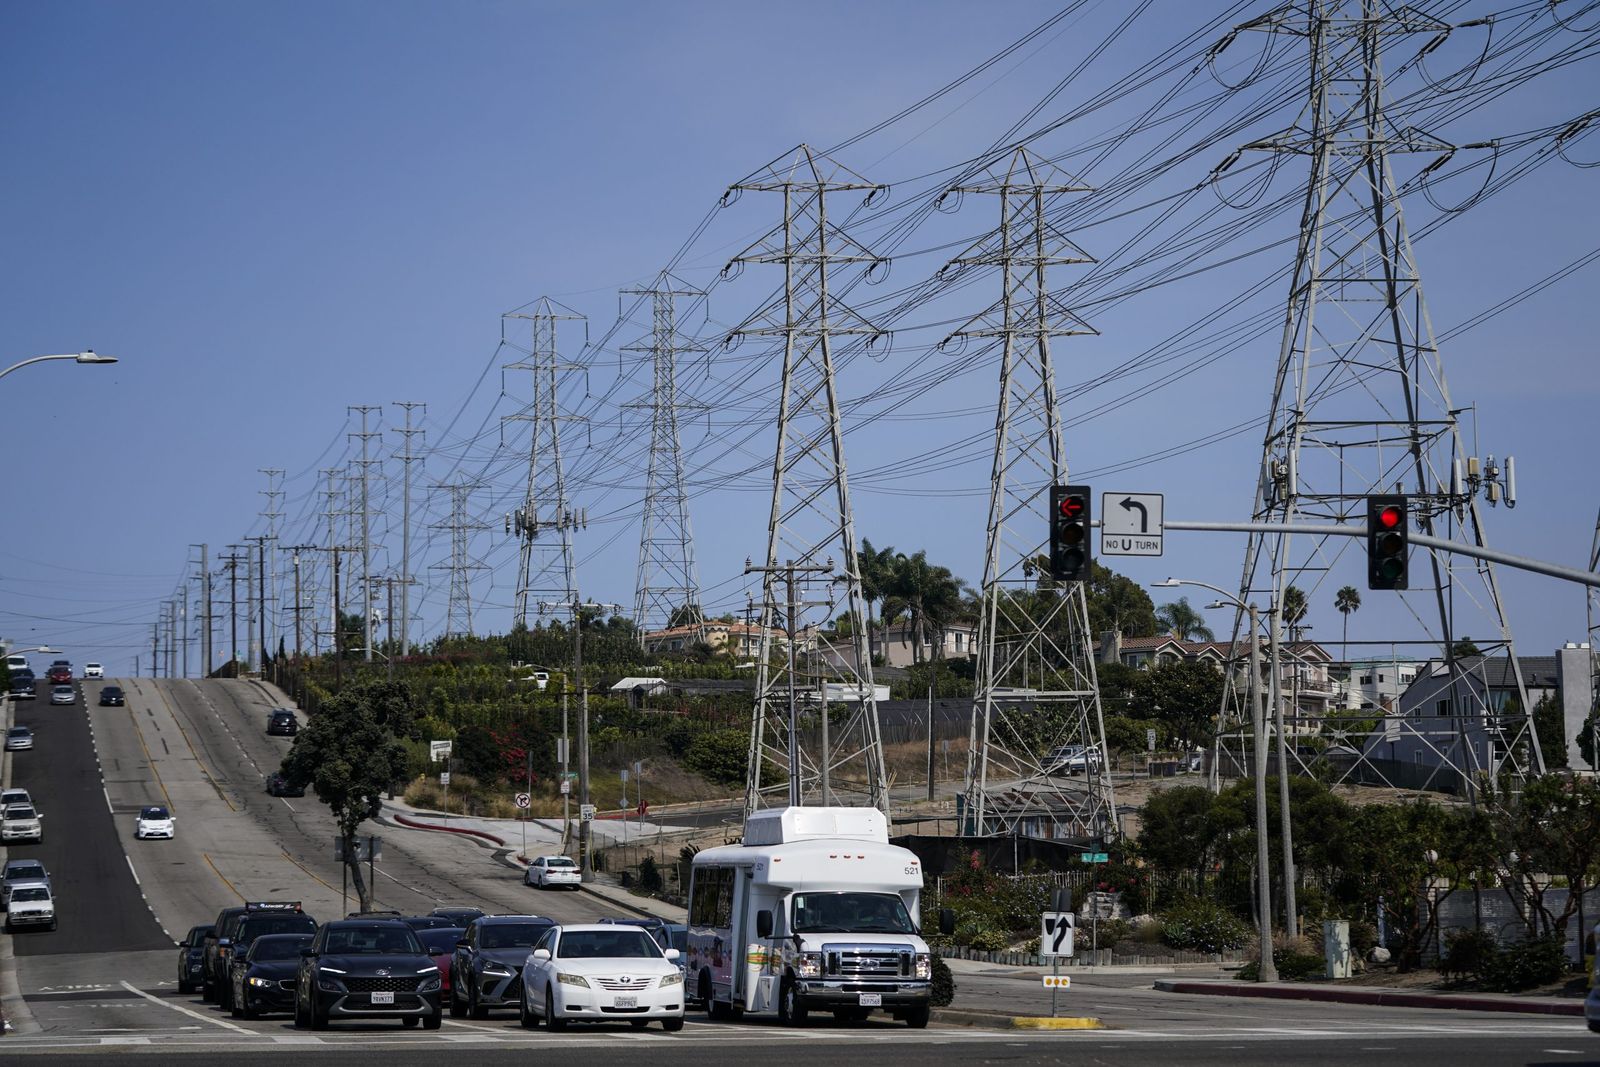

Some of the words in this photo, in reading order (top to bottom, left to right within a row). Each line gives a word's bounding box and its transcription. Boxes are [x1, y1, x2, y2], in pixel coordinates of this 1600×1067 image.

[1106, 540, 1119, 549] NO
[1121, 539, 1132, 551] U
[1135, 541, 1159, 550] TURN
[904, 866, 919, 875] 521
